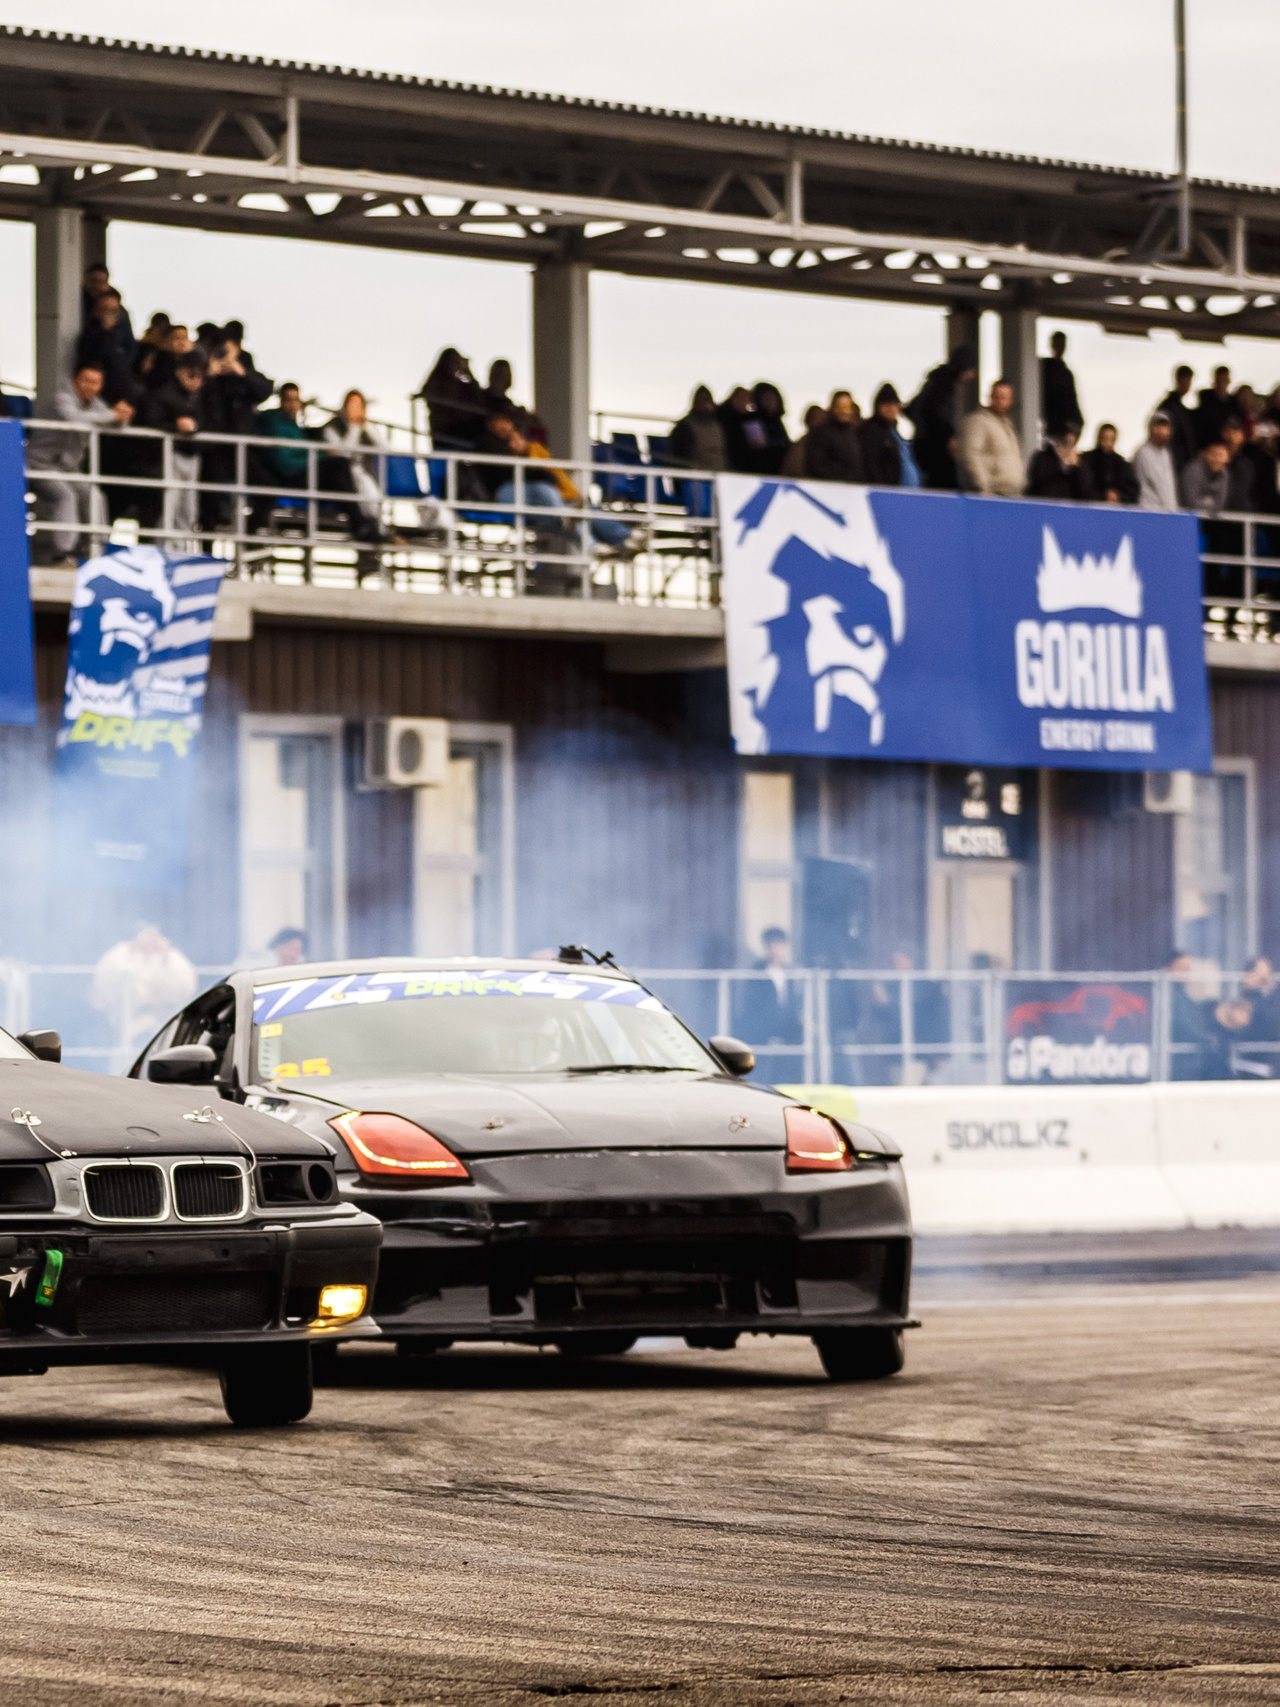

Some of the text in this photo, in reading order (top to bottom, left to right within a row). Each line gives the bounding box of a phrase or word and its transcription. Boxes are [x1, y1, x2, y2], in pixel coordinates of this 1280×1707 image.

[1015, 619, 1175, 713] GORILLA
[69, 710, 194, 757] DRIFT
[1039, 718, 1156, 753] ENERGY DRINK
[404, 979, 524, 996] DRIFT
[1029, 1035, 1150, 1079] Pandora
